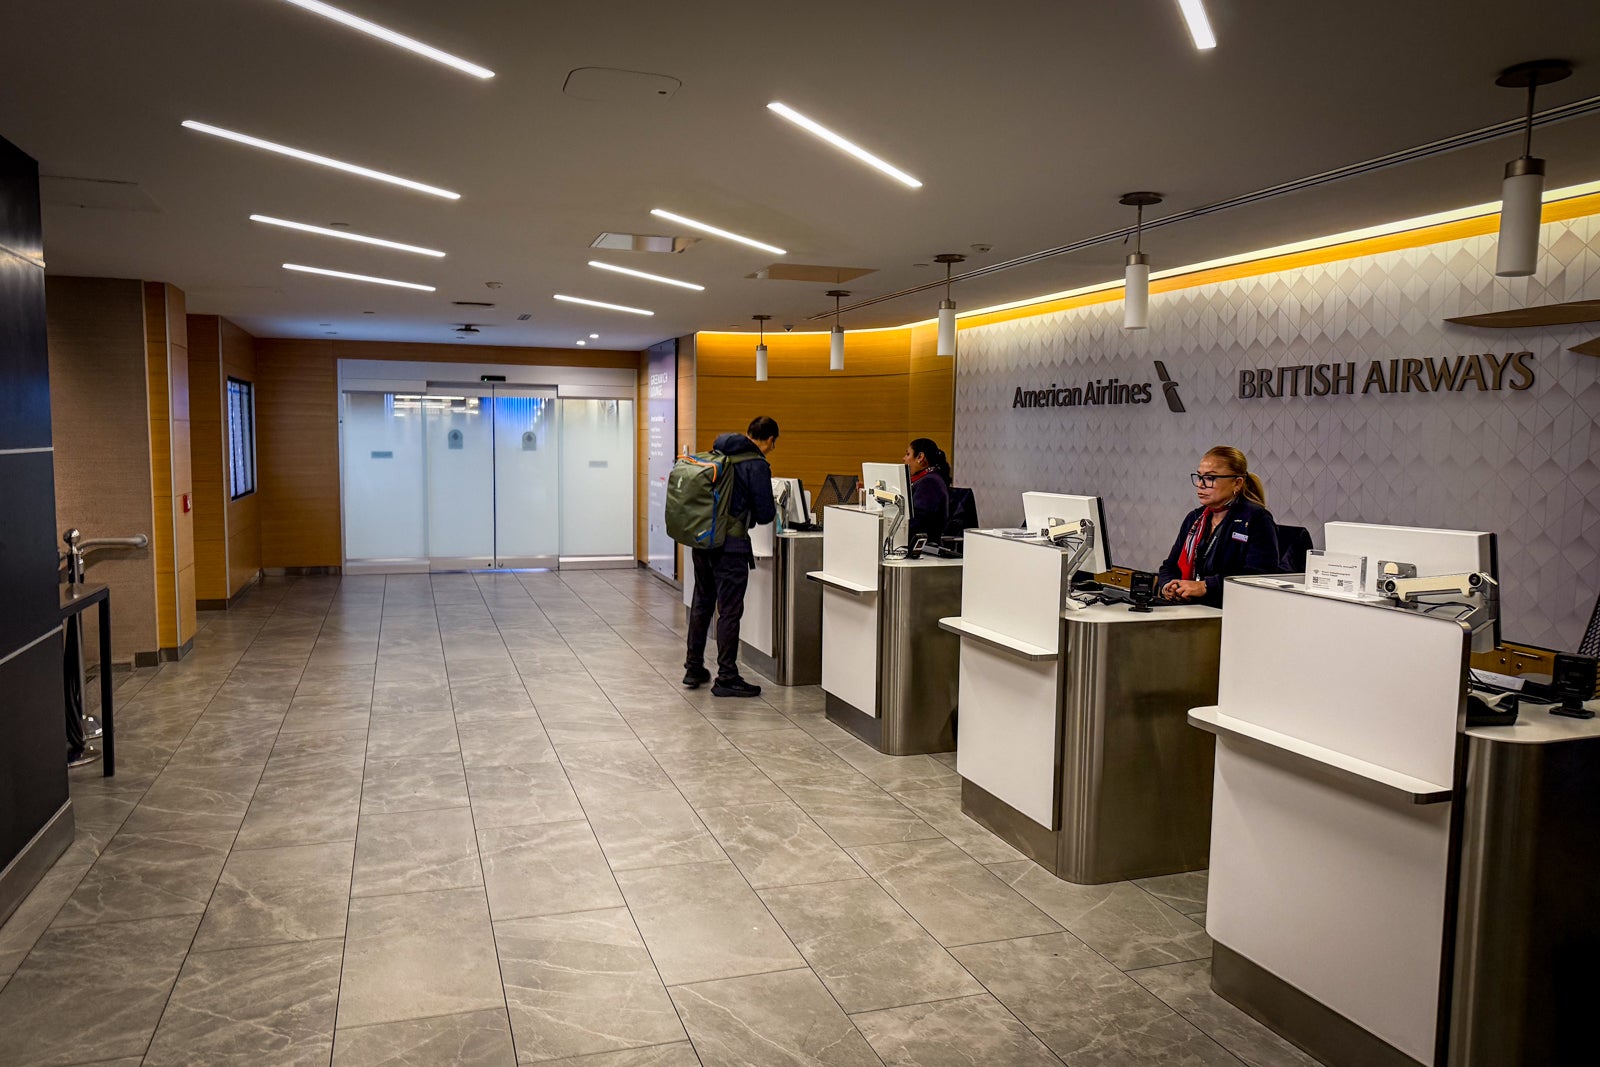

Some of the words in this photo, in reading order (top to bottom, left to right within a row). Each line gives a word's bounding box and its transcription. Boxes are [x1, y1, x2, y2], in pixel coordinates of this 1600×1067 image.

[1012, 384, 1082, 408] American
[1083, 378, 1152, 405] Airlines
[1238, 362, 1355, 399] BRITISH
[1362, 351, 1535, 394] AIRWAYS
